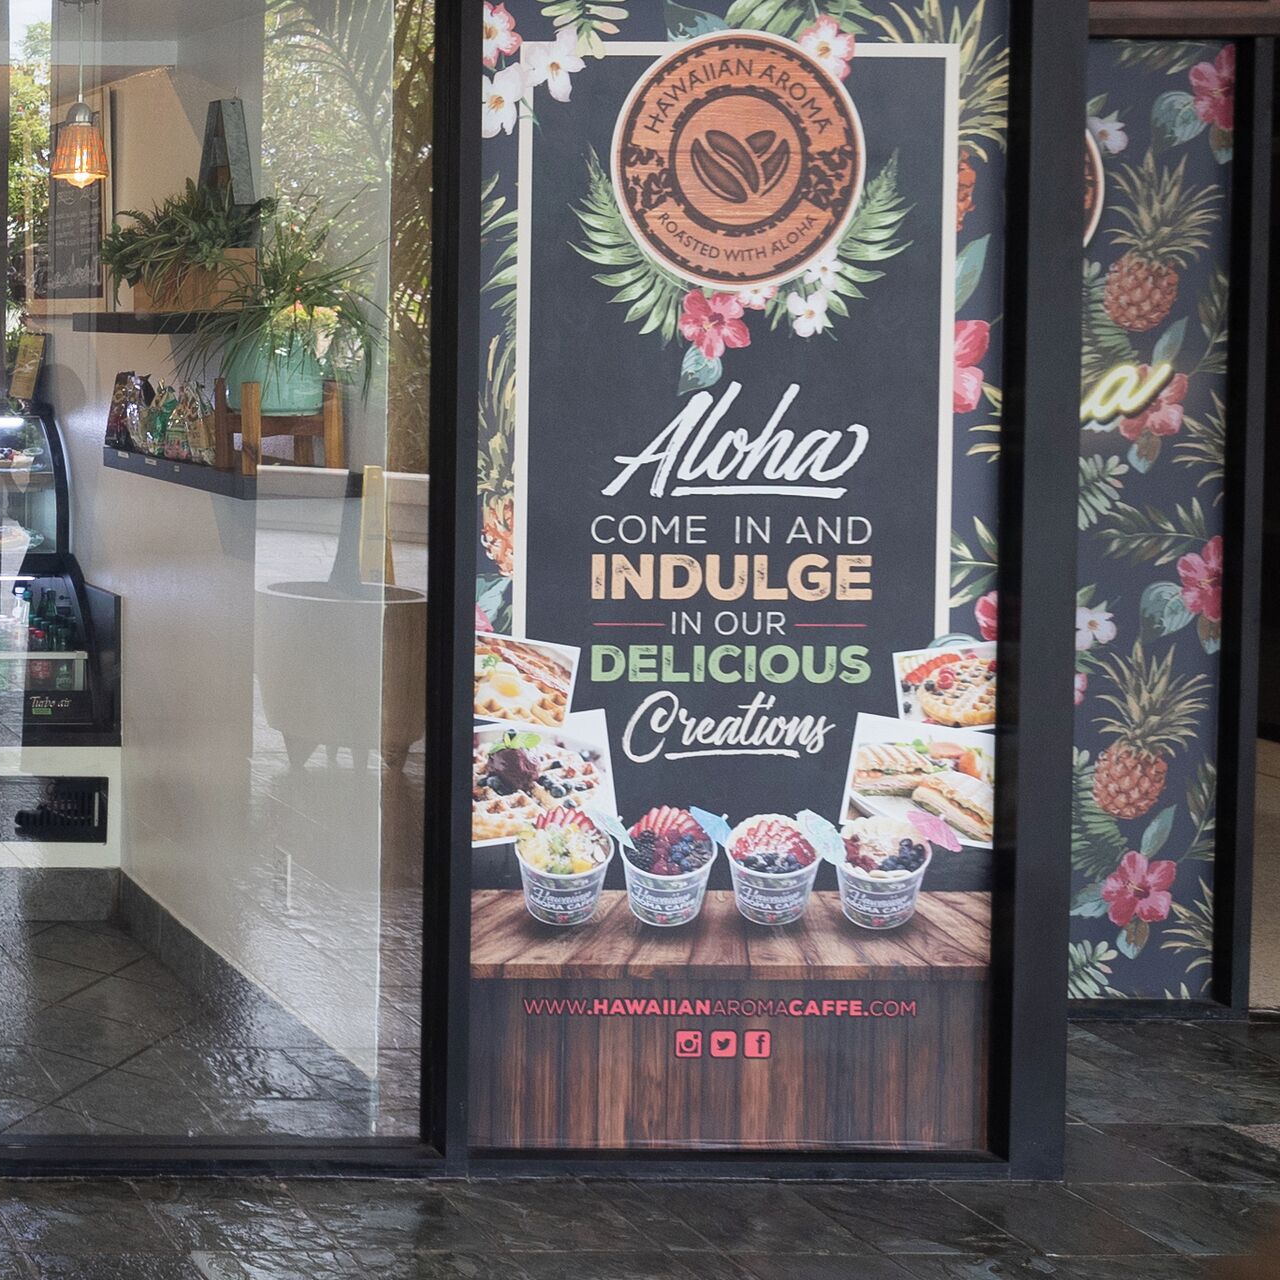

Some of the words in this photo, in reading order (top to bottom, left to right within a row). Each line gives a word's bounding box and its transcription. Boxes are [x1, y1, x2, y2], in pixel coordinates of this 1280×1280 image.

[643, 58, 753, 134] HAWAIIAN
[758, 64, 833, 134] AROMA
[657, 211, 721, 259] ROASTED
[723, 245, 767, 262] WITH
[771, 214, 819, 255] ALOHA
[601, 380, 870, 498] Aloha
[590, 515, 708, 545] COME
[734, 516, 771, 545] IN
[785, 516, 873, 545] AND
[591, 553, 873, 602] INDULGE
[670, 610, 702, 635] IN
[713, 610, 787, 636] OUR
[590, 644, 872, 684] DELICIOUS
[29, 695, 56, 708] Turbo
[57, 697, 72, 708] air
[621, 690, 836, 763] Creations
[522, 998, 918, 1017] WWW.HAWAIIANAROMACAFFE.COM
